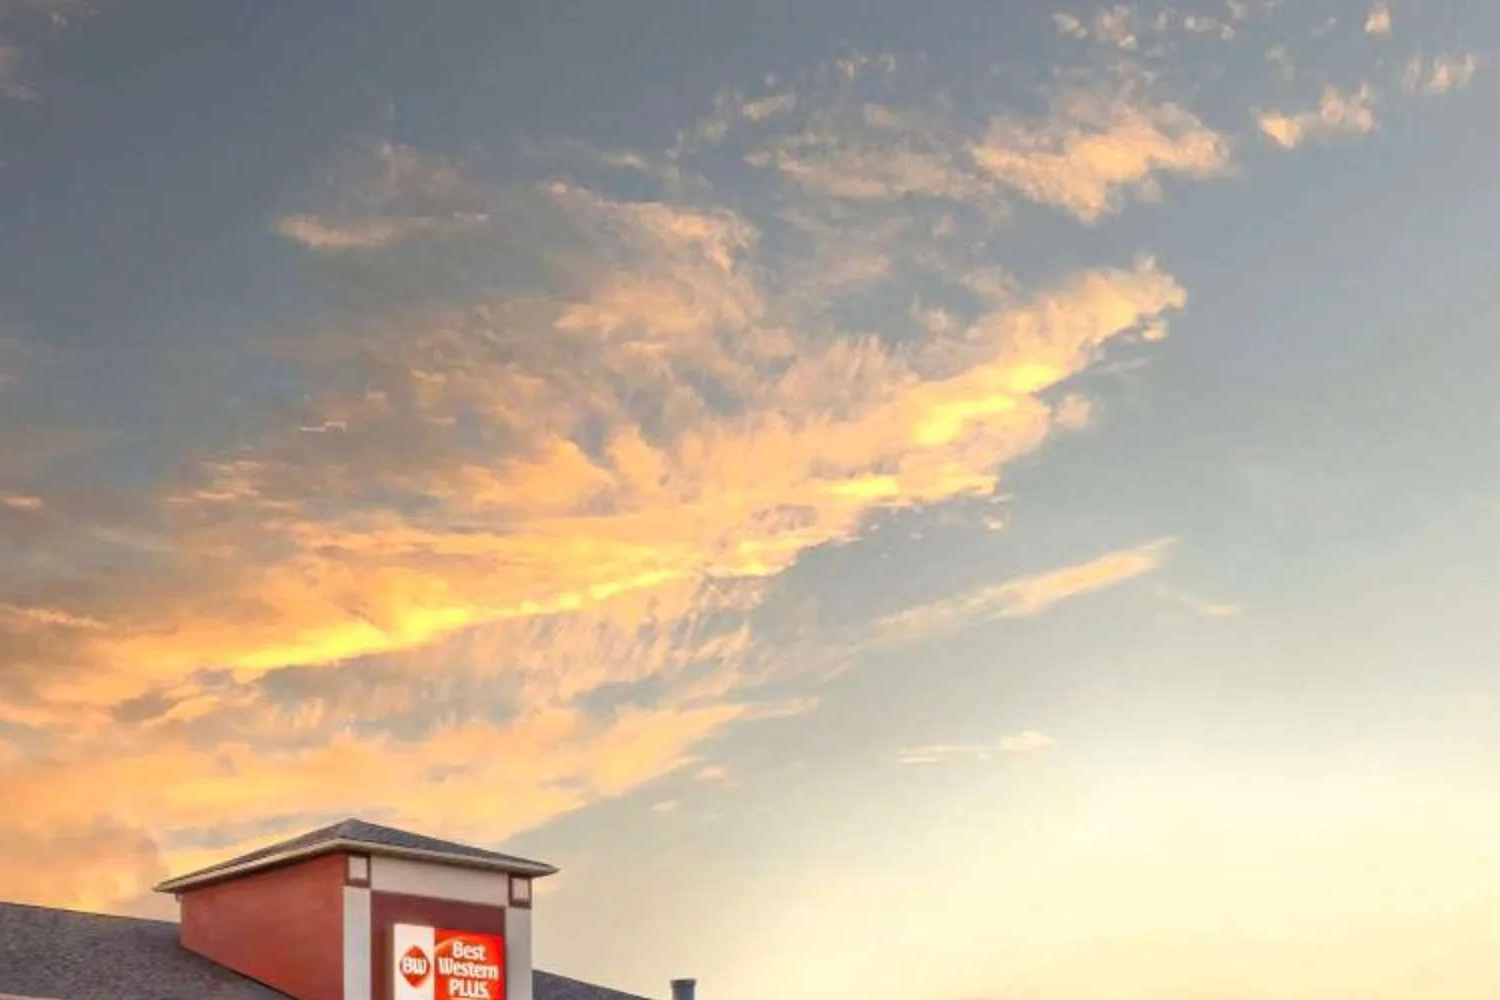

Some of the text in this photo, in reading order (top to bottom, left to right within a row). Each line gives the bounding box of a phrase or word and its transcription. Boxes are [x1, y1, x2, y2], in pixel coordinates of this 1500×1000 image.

[452, 940, 485, 960] Best
[402, 957, 427, 975] BW
[438, 956, 499, 980] Western
[448, 978, 490, 998] PLUS
